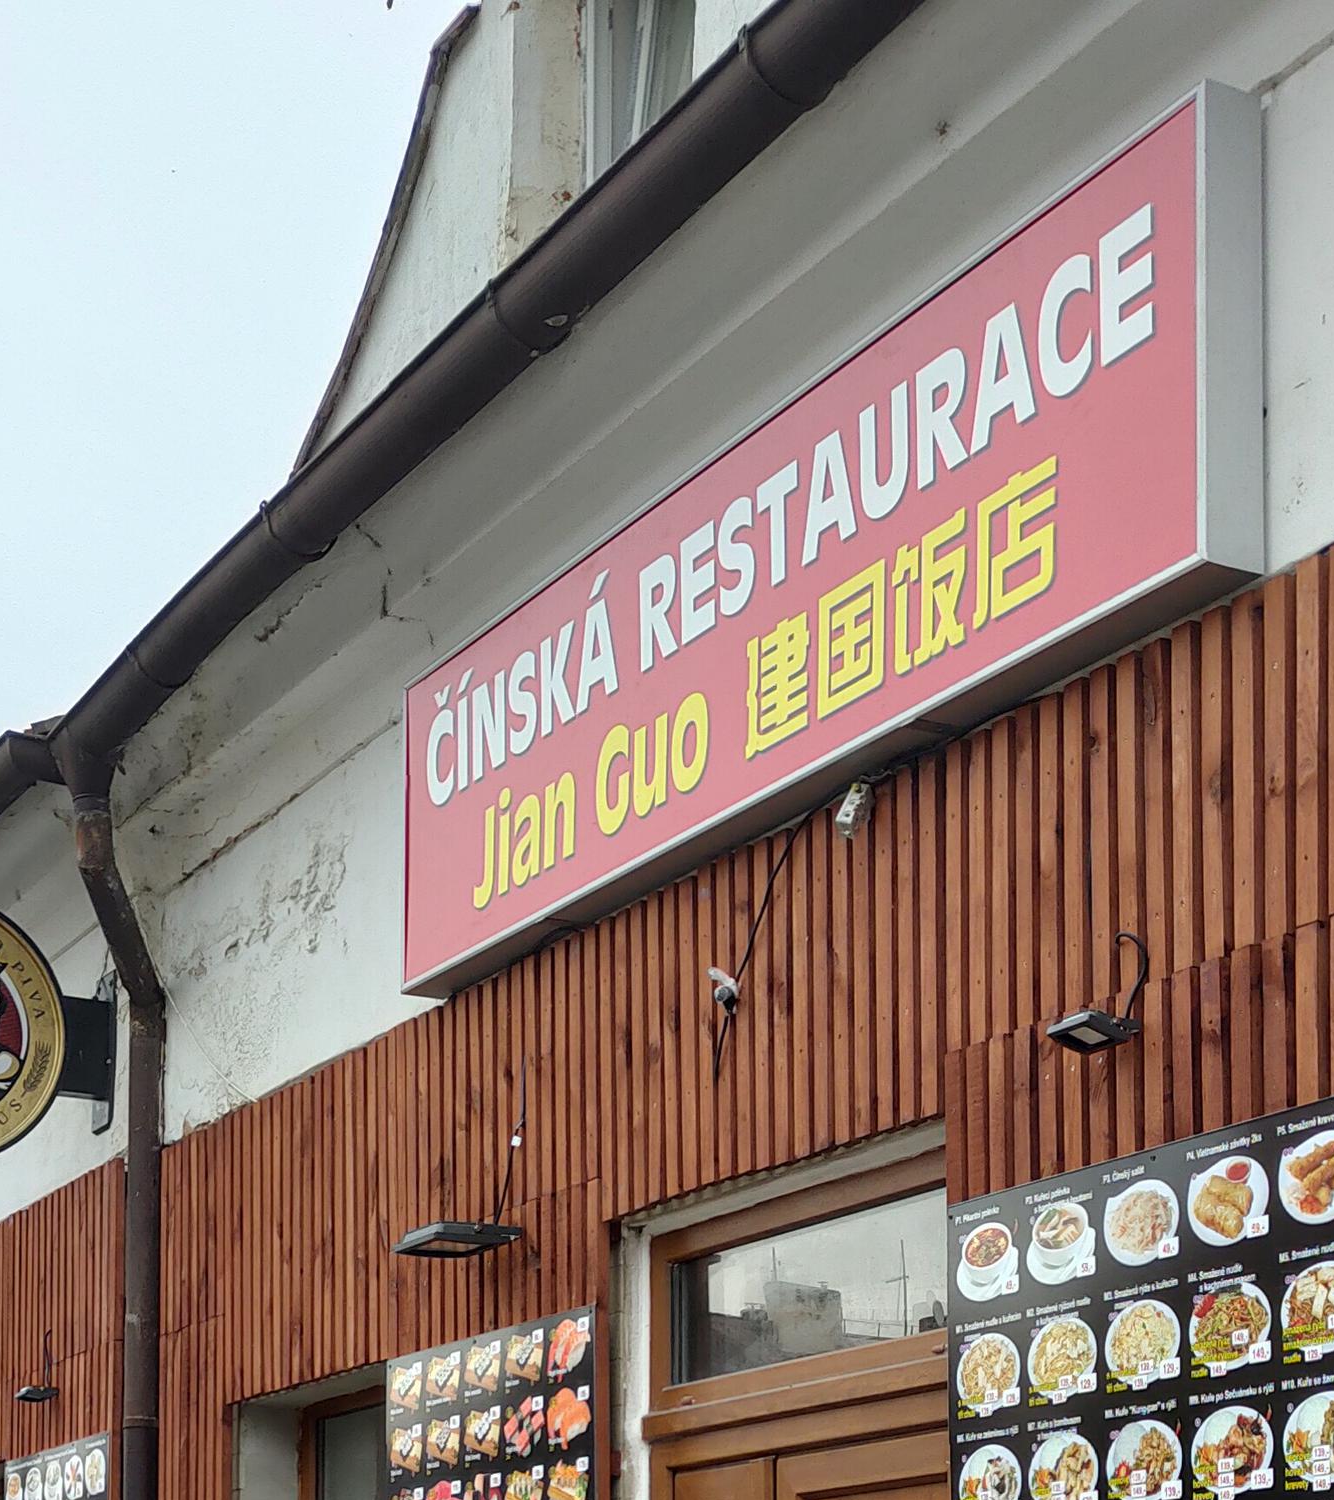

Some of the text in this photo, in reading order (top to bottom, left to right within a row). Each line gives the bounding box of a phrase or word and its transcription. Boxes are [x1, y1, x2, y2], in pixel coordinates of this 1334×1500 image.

[425, 202, 1155, 807] ČÍNSKÁ RESTAURACE
[744, 455, 1059, 759] 建国饭店
[472, 772, 575, 911] Jian
[11, 961, 48, 1020] PIVA
